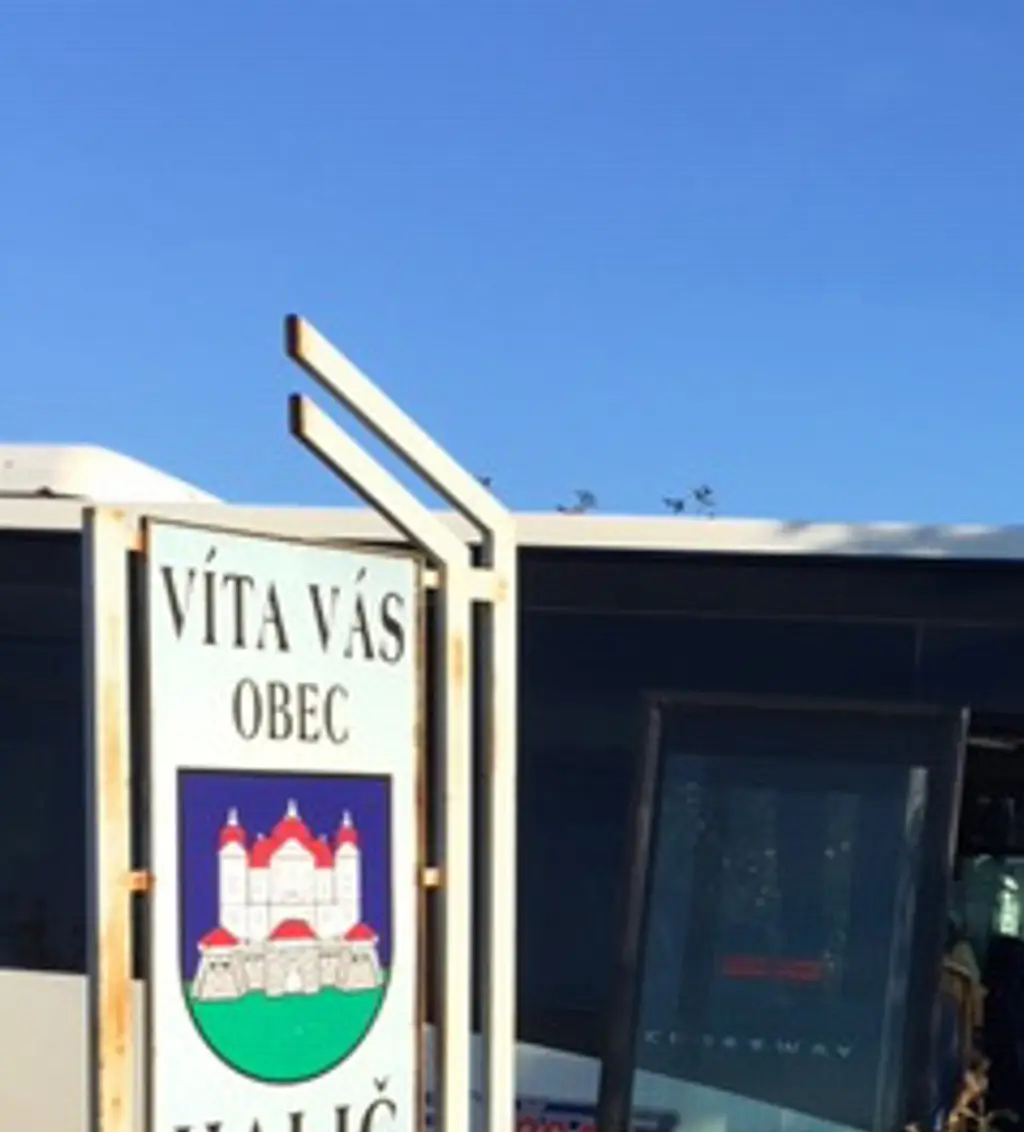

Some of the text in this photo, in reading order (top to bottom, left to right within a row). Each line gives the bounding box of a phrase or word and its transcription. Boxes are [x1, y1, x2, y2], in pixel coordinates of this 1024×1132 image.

[160, 547, 405, 665] VÍTA VÁS
[231, 677, 350, 745] OBEC
